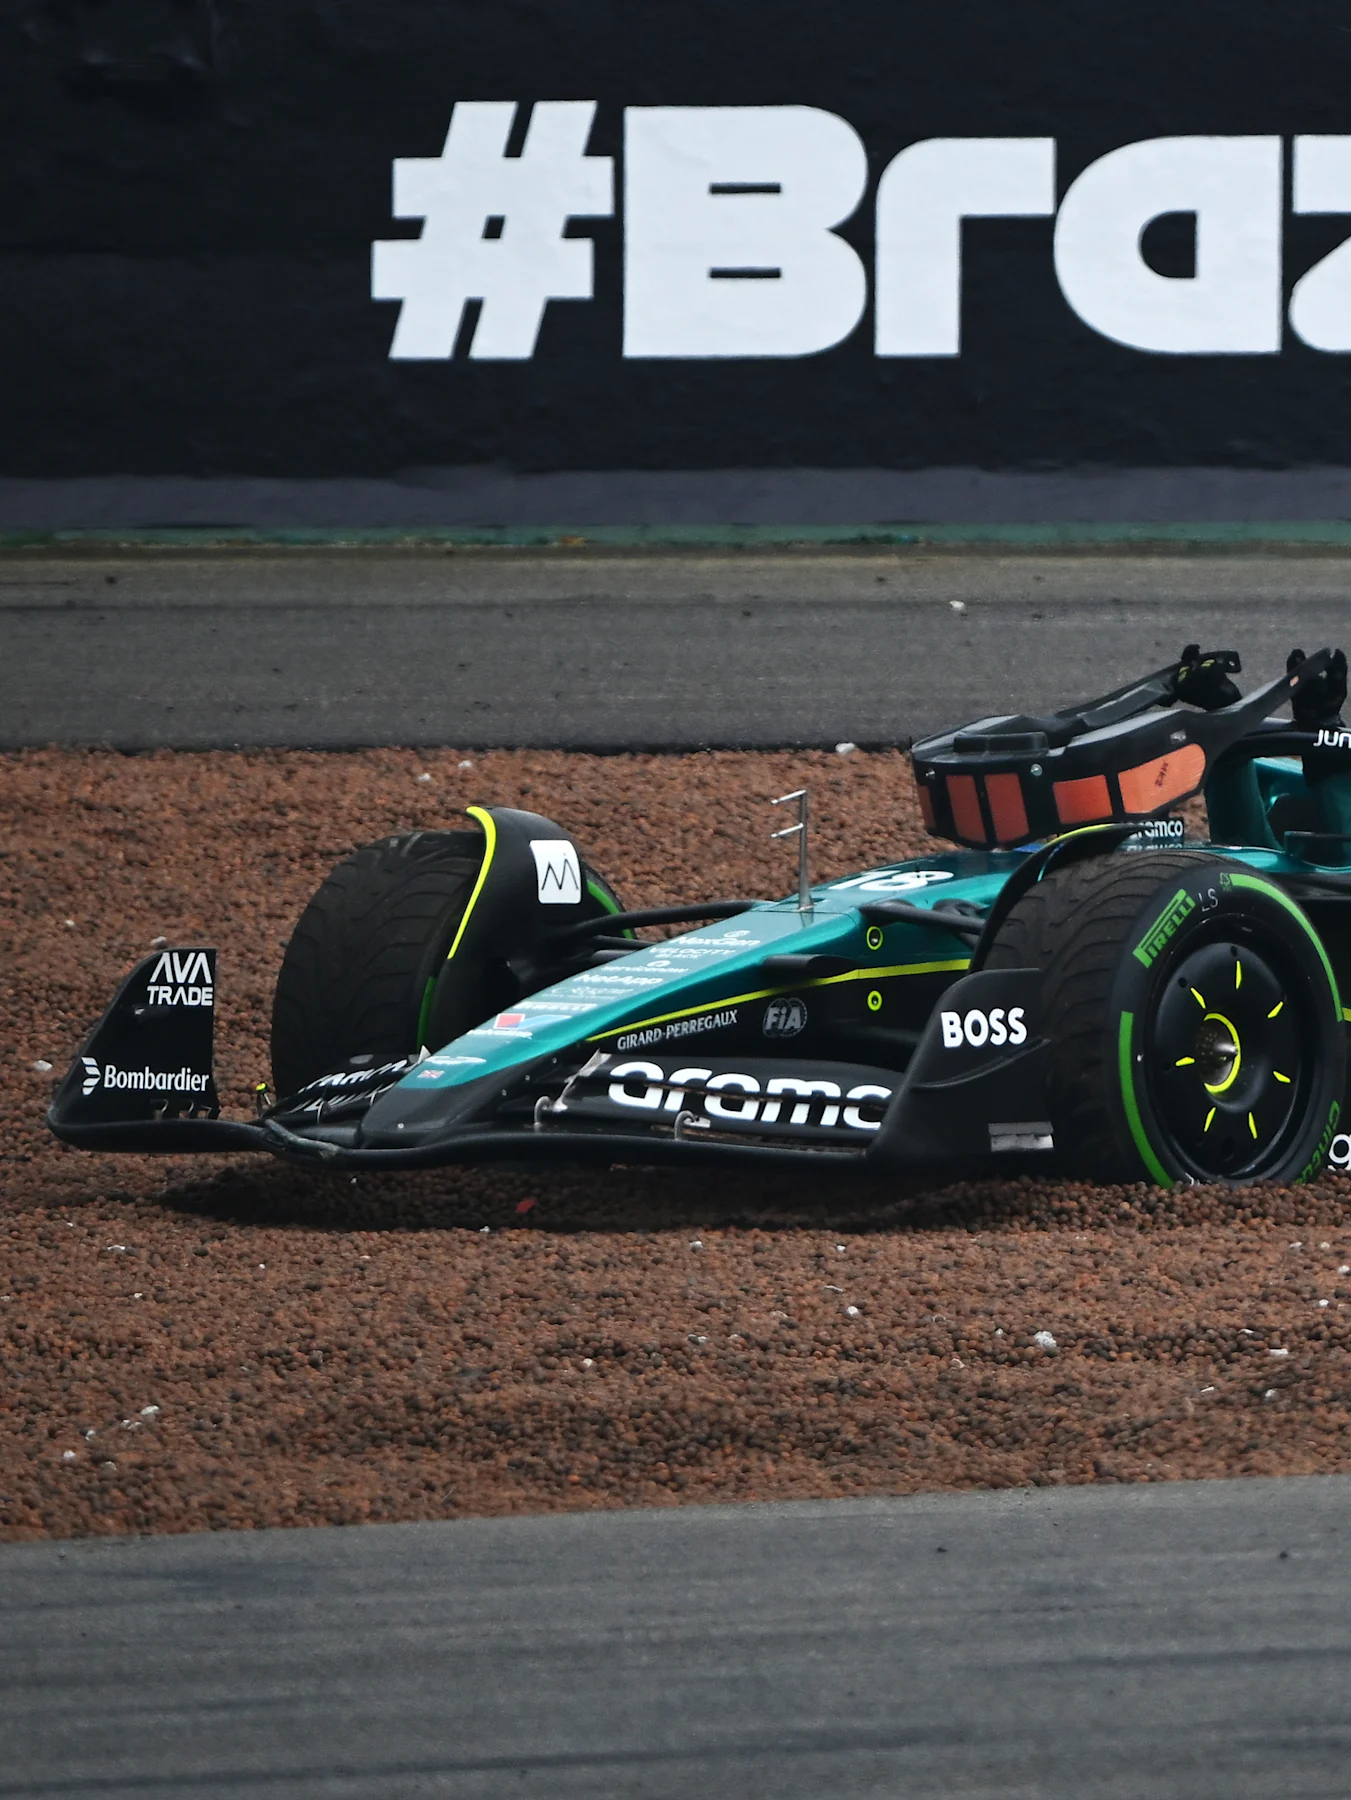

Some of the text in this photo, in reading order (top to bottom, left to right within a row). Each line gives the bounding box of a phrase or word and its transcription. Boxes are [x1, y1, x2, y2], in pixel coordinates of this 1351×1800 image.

[828, 870, 954, 891] 18
[1132, 888, 1197, 969] PIRELLI
[150, 952, 212, 984] AVA
[147, 985, 213, 1006] TRADE
[616, 1009, 738, 1050] GIRARD-PERREGAUX
[941, 1008, 1027, 1048] BOSS
[104, 1064, 209, 1091] Bombardier
